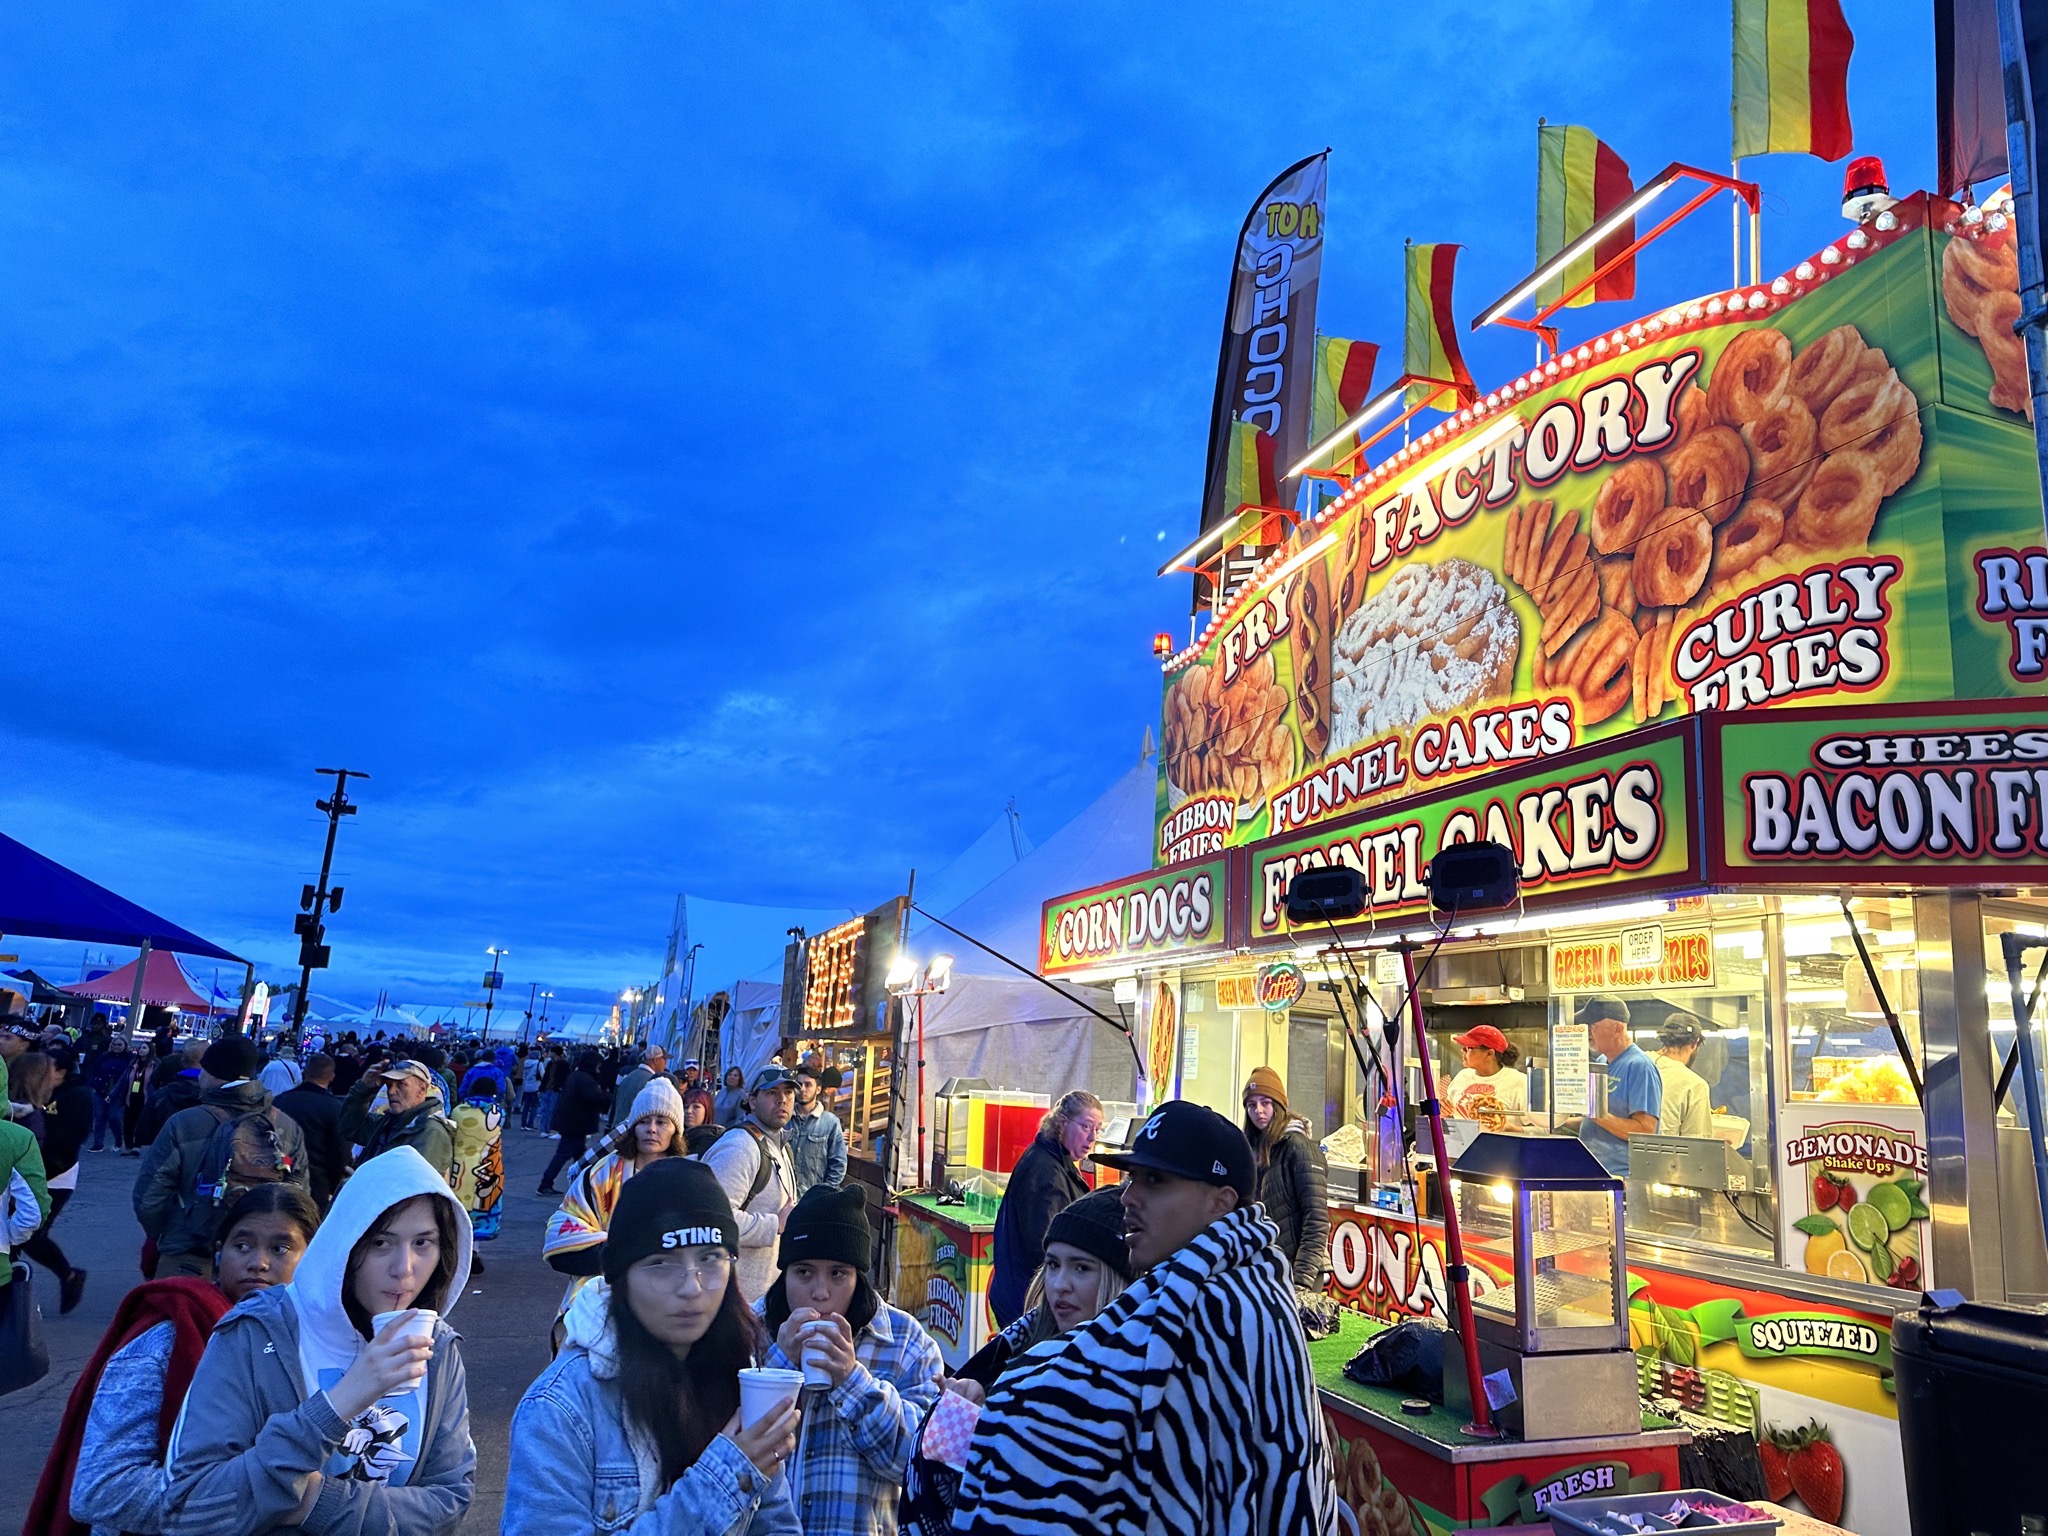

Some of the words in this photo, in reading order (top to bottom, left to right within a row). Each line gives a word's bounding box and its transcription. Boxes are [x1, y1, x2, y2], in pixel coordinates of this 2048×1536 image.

[1222, 573, 1297, 684] FRY
[1369, 351, 1700, 568] FACTORY
[1676, 564, 1896, 681] CURLY
[1690, 627, 1882, 712] FRIES
[1270, 740, 1406, 836] FUNNEL
[1414, 702, 1573, 776] CAKES
[1162, 799, 1234, 851] RIBBON
[1749, 772, 1974, 852] BACON
[1168, 832, 1223, 865] FRIES
[1059, 897, 1125, 957] CORN
[1128, 875, 1212, 946] DOGS
[1628, 931, 1655, 946] ORDER
[1631, 946, 1651, 959] HERE
[1555, 944, 1604, 988] GREEN
[1261, 973, 1299, 1003] Coffee
[1788, 1134, 1928, 1172] LEMONADE
[1825, 1156, 1863, 1169] Shake
[1866, 1160, 1891, 1173] Ups
[662, 1226, 722, 1249] STING
[937, 1245, 956, 1261] FRESH
[927, 1278, 963, 1321] RIBBON
[930, 1304, 958, 1343] FRIES
[1751, 1319, 1879, 1355] SQUEEZED
[1533, 1466, 1615, 1513] FRESH
